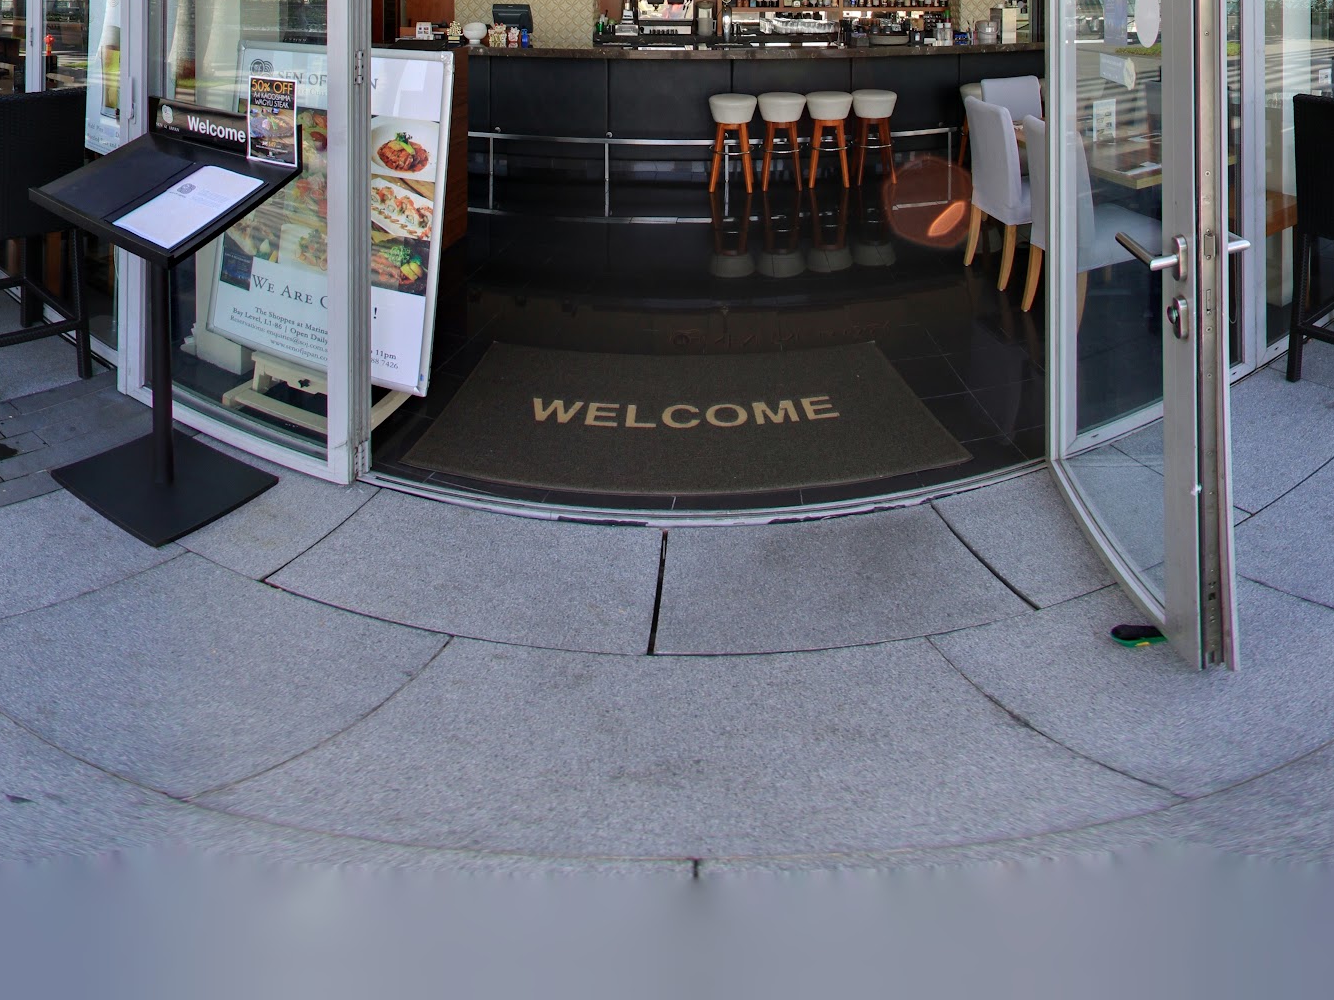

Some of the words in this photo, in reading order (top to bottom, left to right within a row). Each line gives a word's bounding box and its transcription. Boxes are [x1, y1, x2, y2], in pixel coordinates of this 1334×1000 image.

[251, 79, 271, 92] 50%
[273, 81, 294, 95] OFF
[187, 115, 246, 143] Welcome
[232, 307, 243, 317] Bay
[244, 311, 263, 324] Level,
[264, 318, 283, 330] L1-86
[290, 327, 309, 339] Open
[310, 333, 328, 346] Daily
[255, 306, 267, 316] The
[268, 311, 295, 325] Shoppes
[305, 323, 328, 336] Marina
[266, 329, 328, 353] enquiries@soj.com.s
[270, 339, 328, 361] www.senofjapan.co
[375, 350, 397, 360] 11pm
[533, 396, 840, 429] WELCOME
